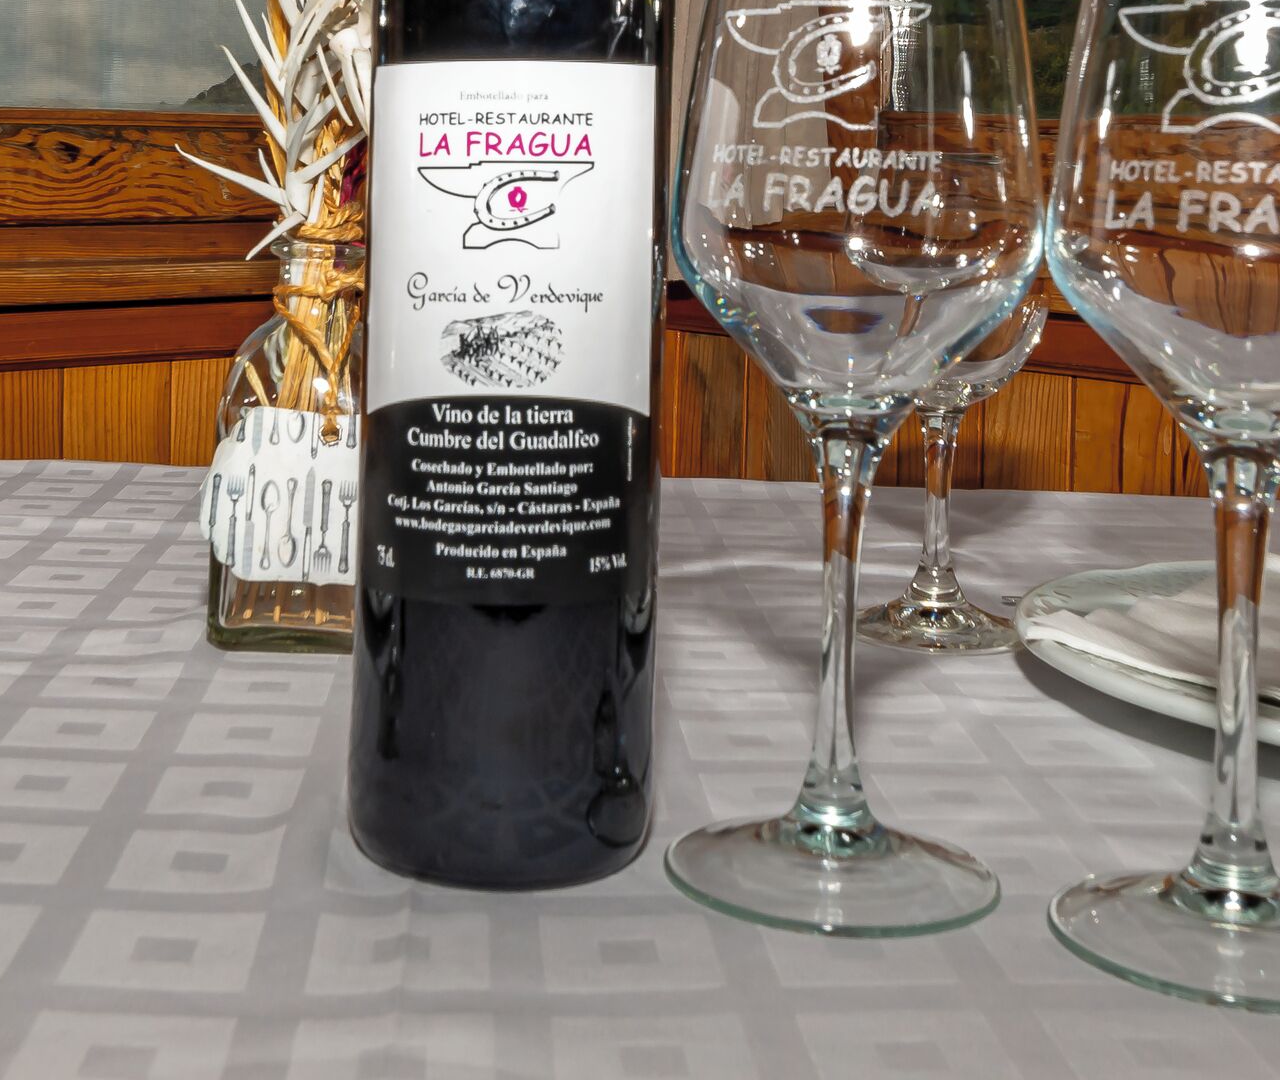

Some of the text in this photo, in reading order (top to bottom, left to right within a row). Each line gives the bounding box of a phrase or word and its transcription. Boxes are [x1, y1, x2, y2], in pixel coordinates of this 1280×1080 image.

[526, 92, 549, 103] para
[419, 111, 594, 126] HOTEL-RESTAURANTE
[419, 131, 593, 158] LA FRAGUA
[711, 143, 944, 173] HOTEL-RESTAURANTE
[707, 170, 941, 219] LA FRAGUA
[1104, 189, 1155, 231] LA
[406, 271, 604, 313] García de Verdevique
[432, 403, 574, 425] Vino de la tierra
[407, 426, 600, 451] Cumbre del Guadalfeo
[411, 458, 594, 479] Cosechado y Embotellado por:
[426, 479, 578, 497] Antonio García Santiago
[412, 496, 432, 512] Los
[583, 496, 621, 513] España
[435, 542, 567, 561] Producido en España
